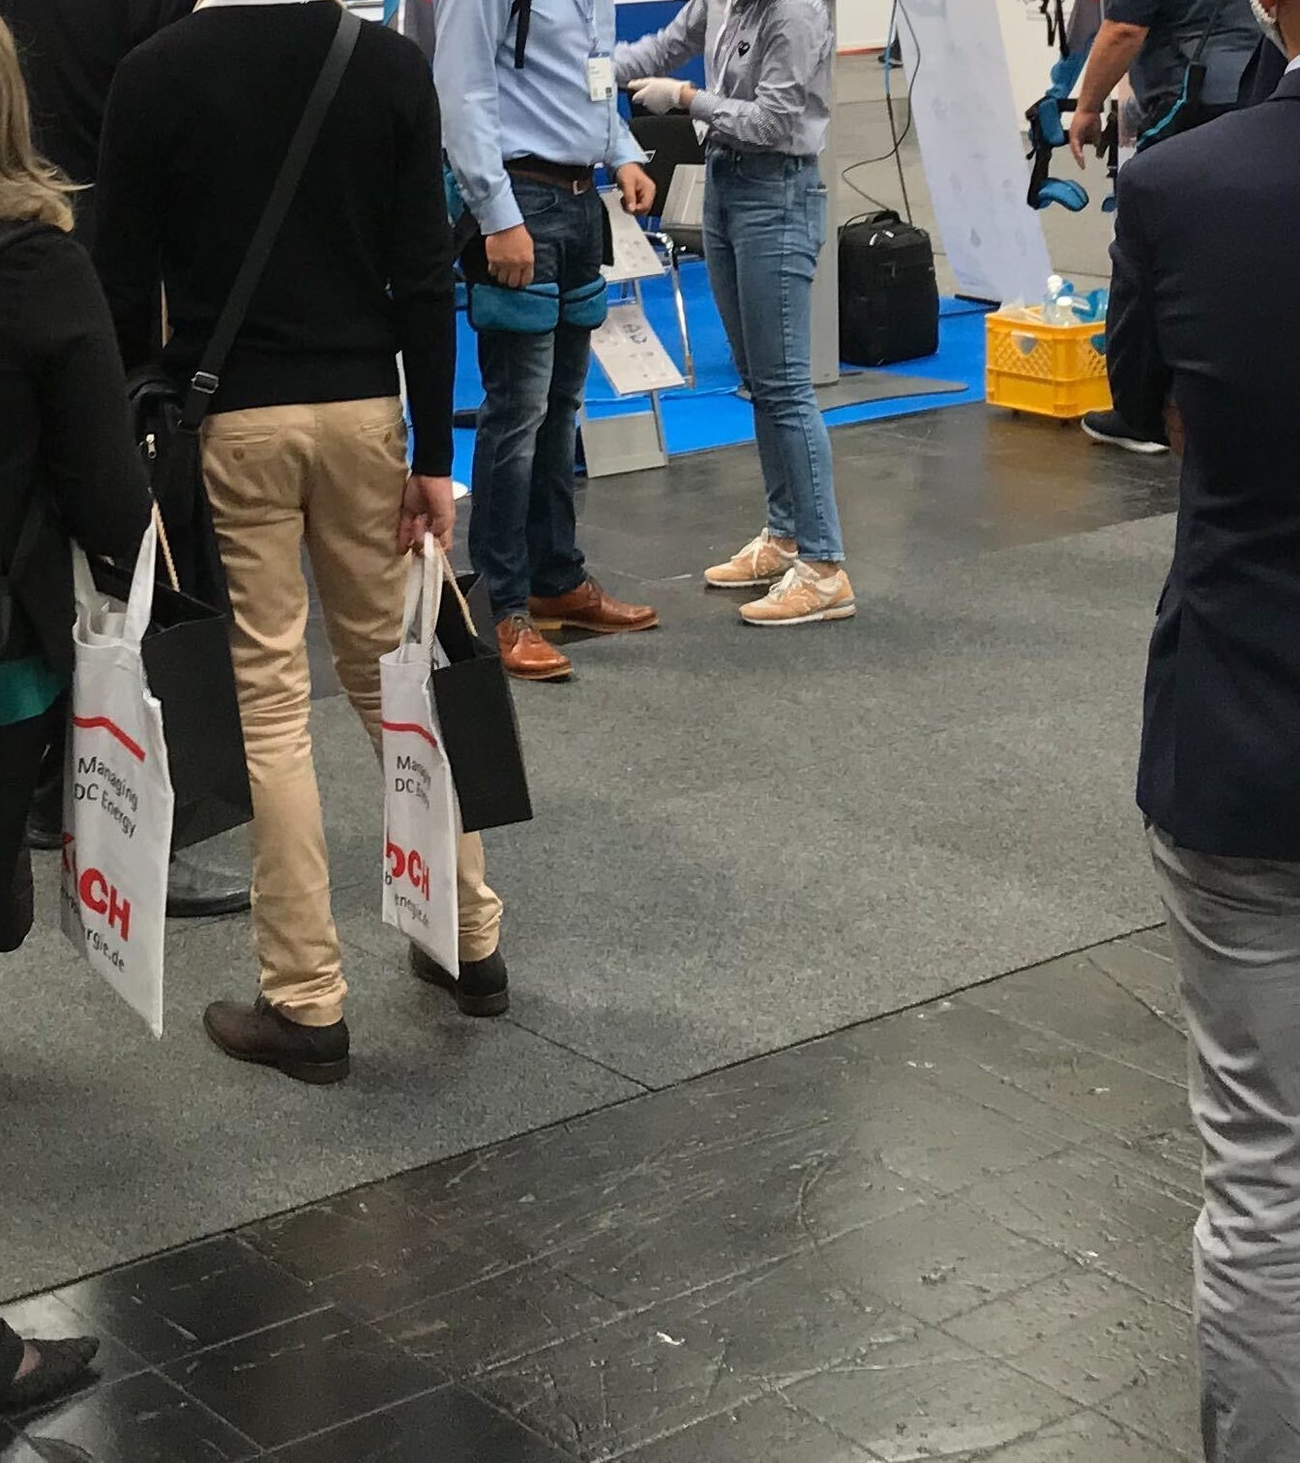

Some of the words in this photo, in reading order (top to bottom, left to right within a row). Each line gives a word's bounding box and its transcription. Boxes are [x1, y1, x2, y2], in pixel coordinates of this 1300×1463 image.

[74, 782, 100, 802] DC
[101, 788, 138, 840] Energy
[77, 755, 140, 812] Managing
[395, 777, 414, 794] DC
